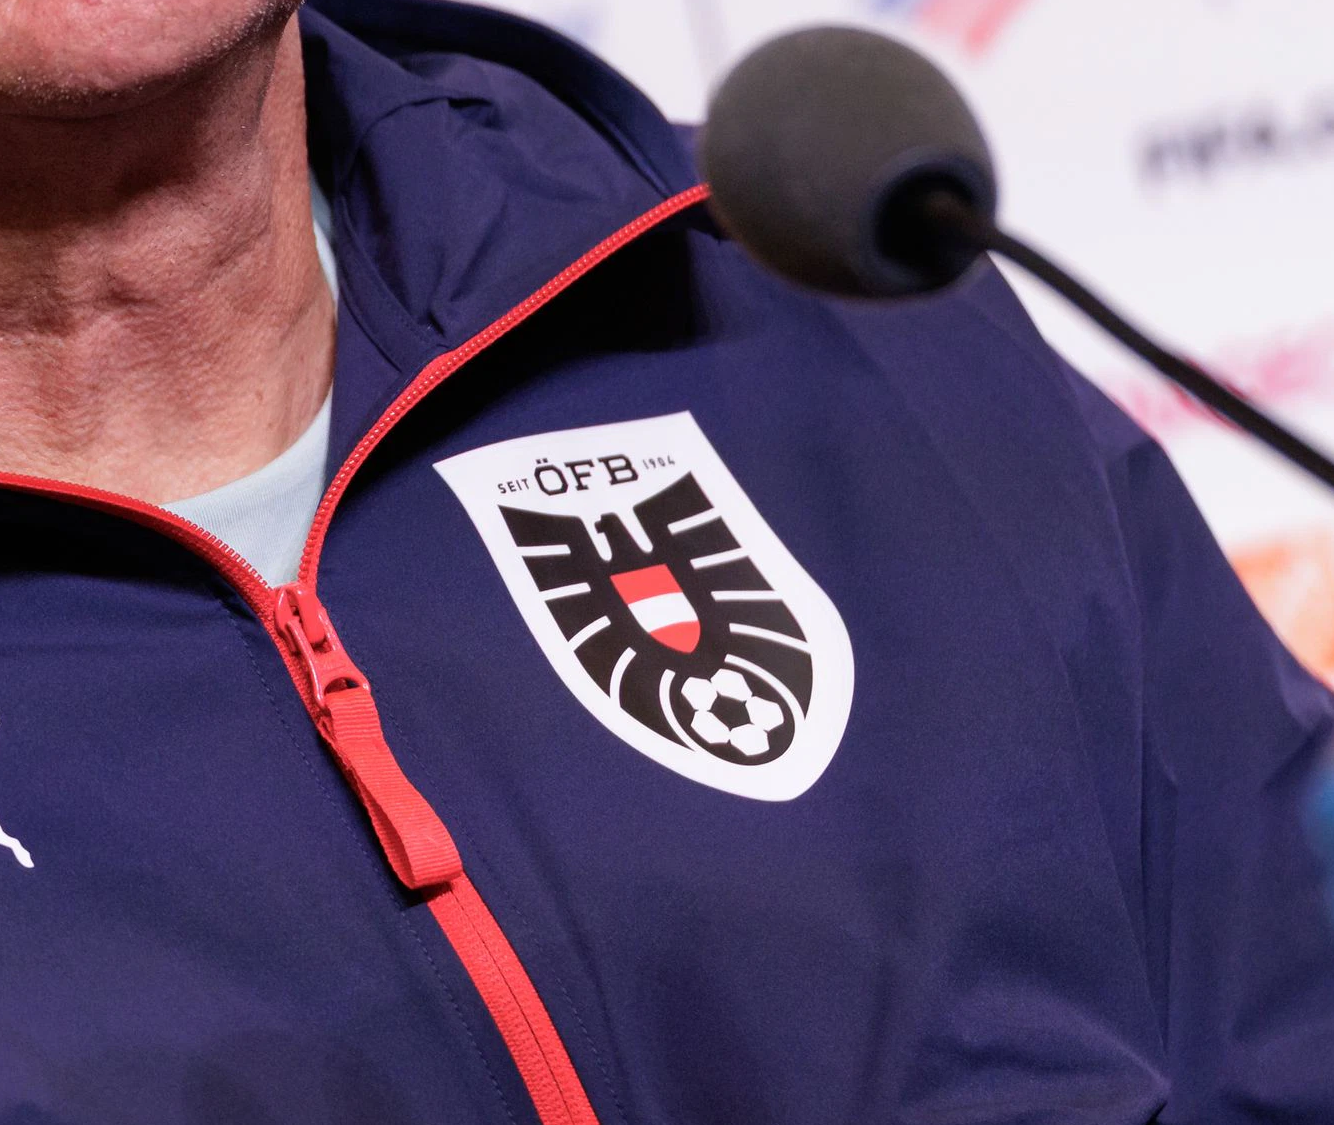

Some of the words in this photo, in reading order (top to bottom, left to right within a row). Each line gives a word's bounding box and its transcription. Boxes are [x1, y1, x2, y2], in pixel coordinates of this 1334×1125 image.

[497, 478, 530, 494] SEIT
[534, 454, 639, 496] ÖFB
[643, 455, 675, 469] 1904
